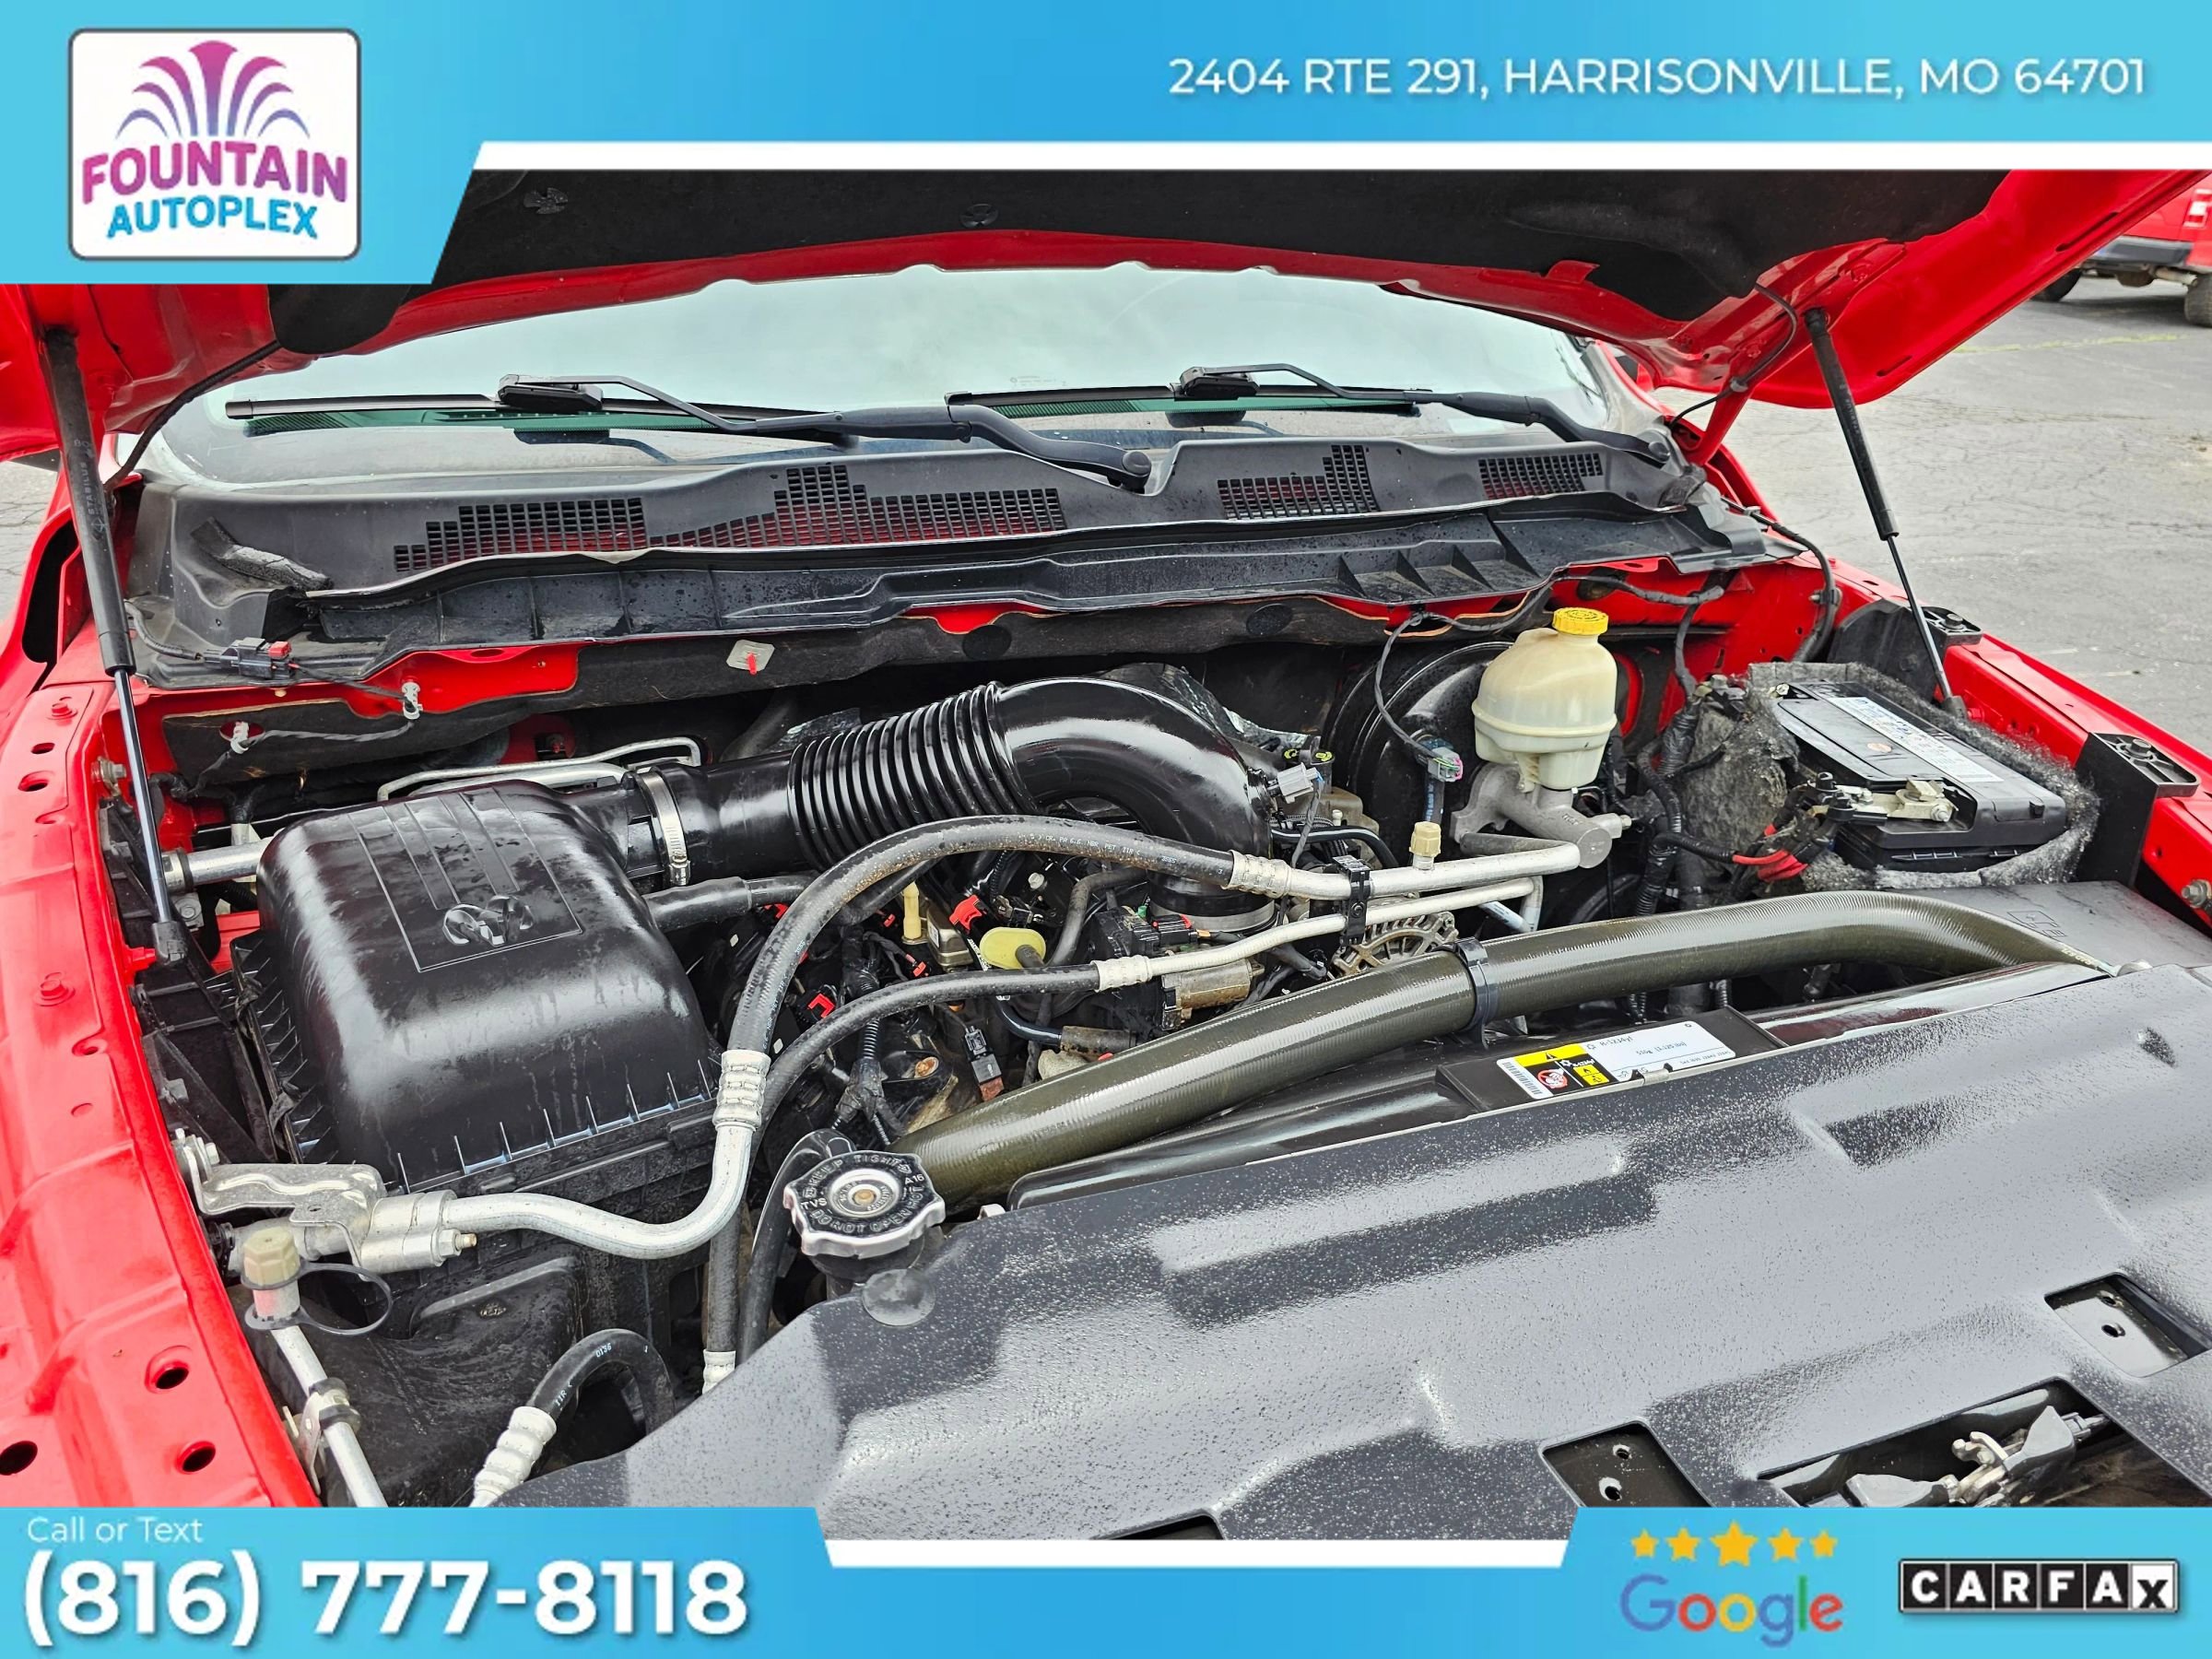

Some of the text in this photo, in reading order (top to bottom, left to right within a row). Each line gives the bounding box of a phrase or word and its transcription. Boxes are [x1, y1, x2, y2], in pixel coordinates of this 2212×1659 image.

[80, 462, 95, 515] STABILUS
[807, 1154, 900, 1186] KEEP TIGHT
[904, 1173, 925, 1185] A16
[800, 1197, 828, 1210] TVS
[810, 1208, 832, 1225] DO
[830, 1220, 866, 1234] NOT
[869, 1207, 913, 1233] OPEN
